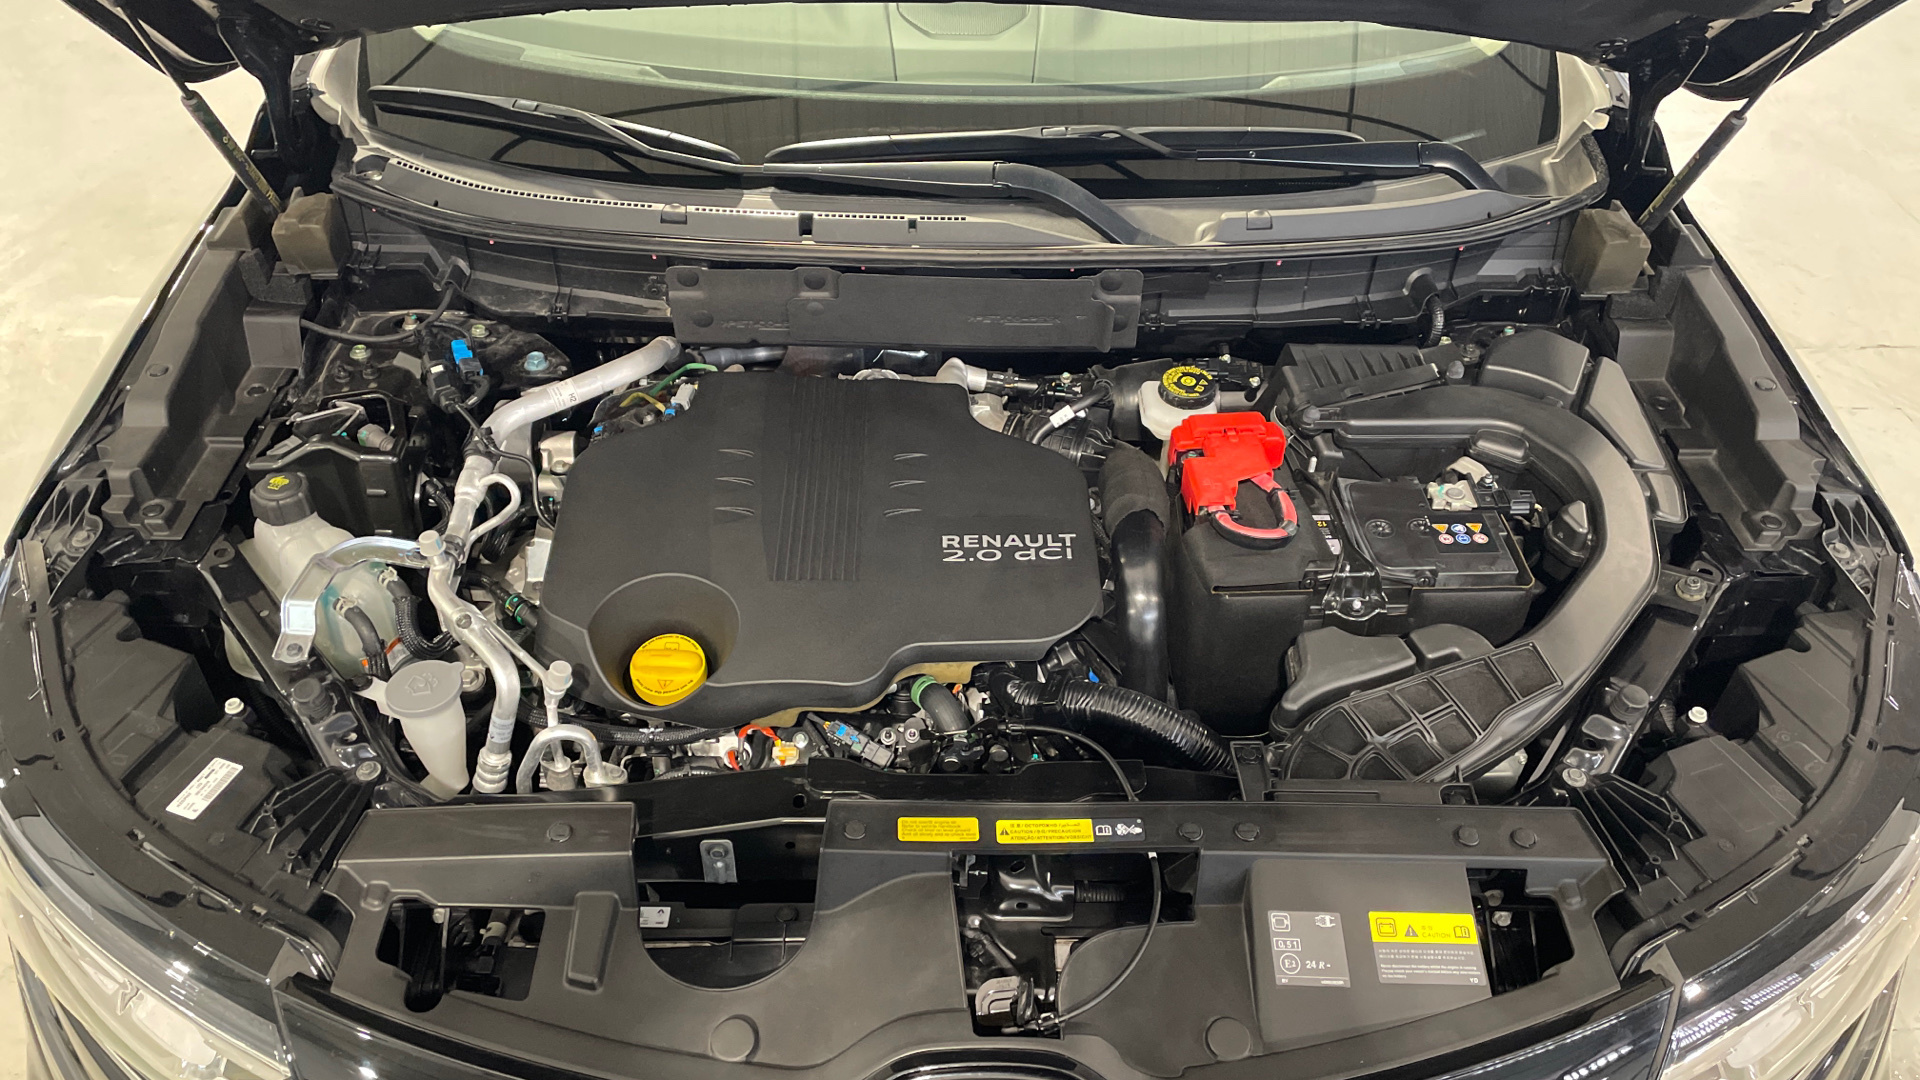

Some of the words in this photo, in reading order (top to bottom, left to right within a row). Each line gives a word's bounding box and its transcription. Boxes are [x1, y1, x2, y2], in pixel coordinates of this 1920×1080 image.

[941, 533, 1077, 548] RENAULT
[942, 549, 1002, 562] 2.0
[1421, 931, 1451, 939] CAUTION
[1305, 960, 1317, 969] 24
